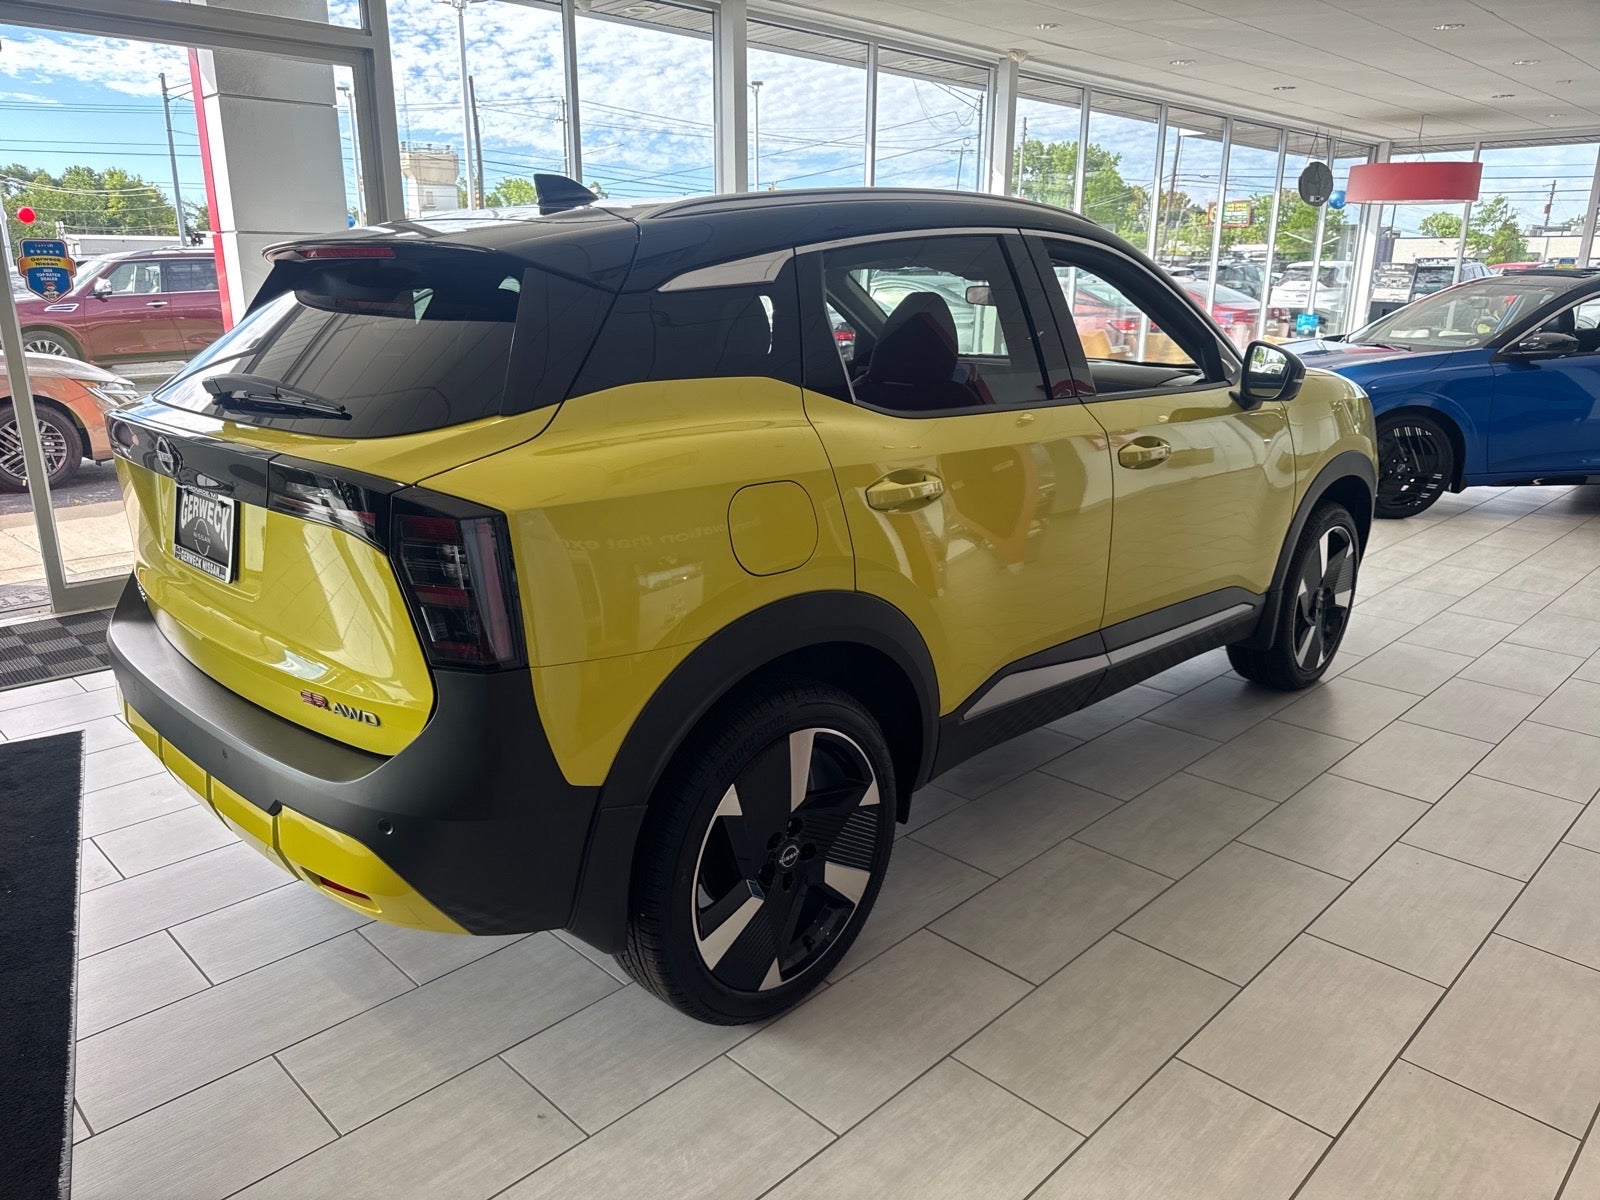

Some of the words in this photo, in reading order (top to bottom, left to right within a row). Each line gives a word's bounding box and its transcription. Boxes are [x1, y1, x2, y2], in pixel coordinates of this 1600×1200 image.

[181, 492, 231, 551] GERWECK
[193, 531, 211, 545] NISSAN
[180, 549, 203, 569] GERWECK
[333, 702, 381, 727] AWD
